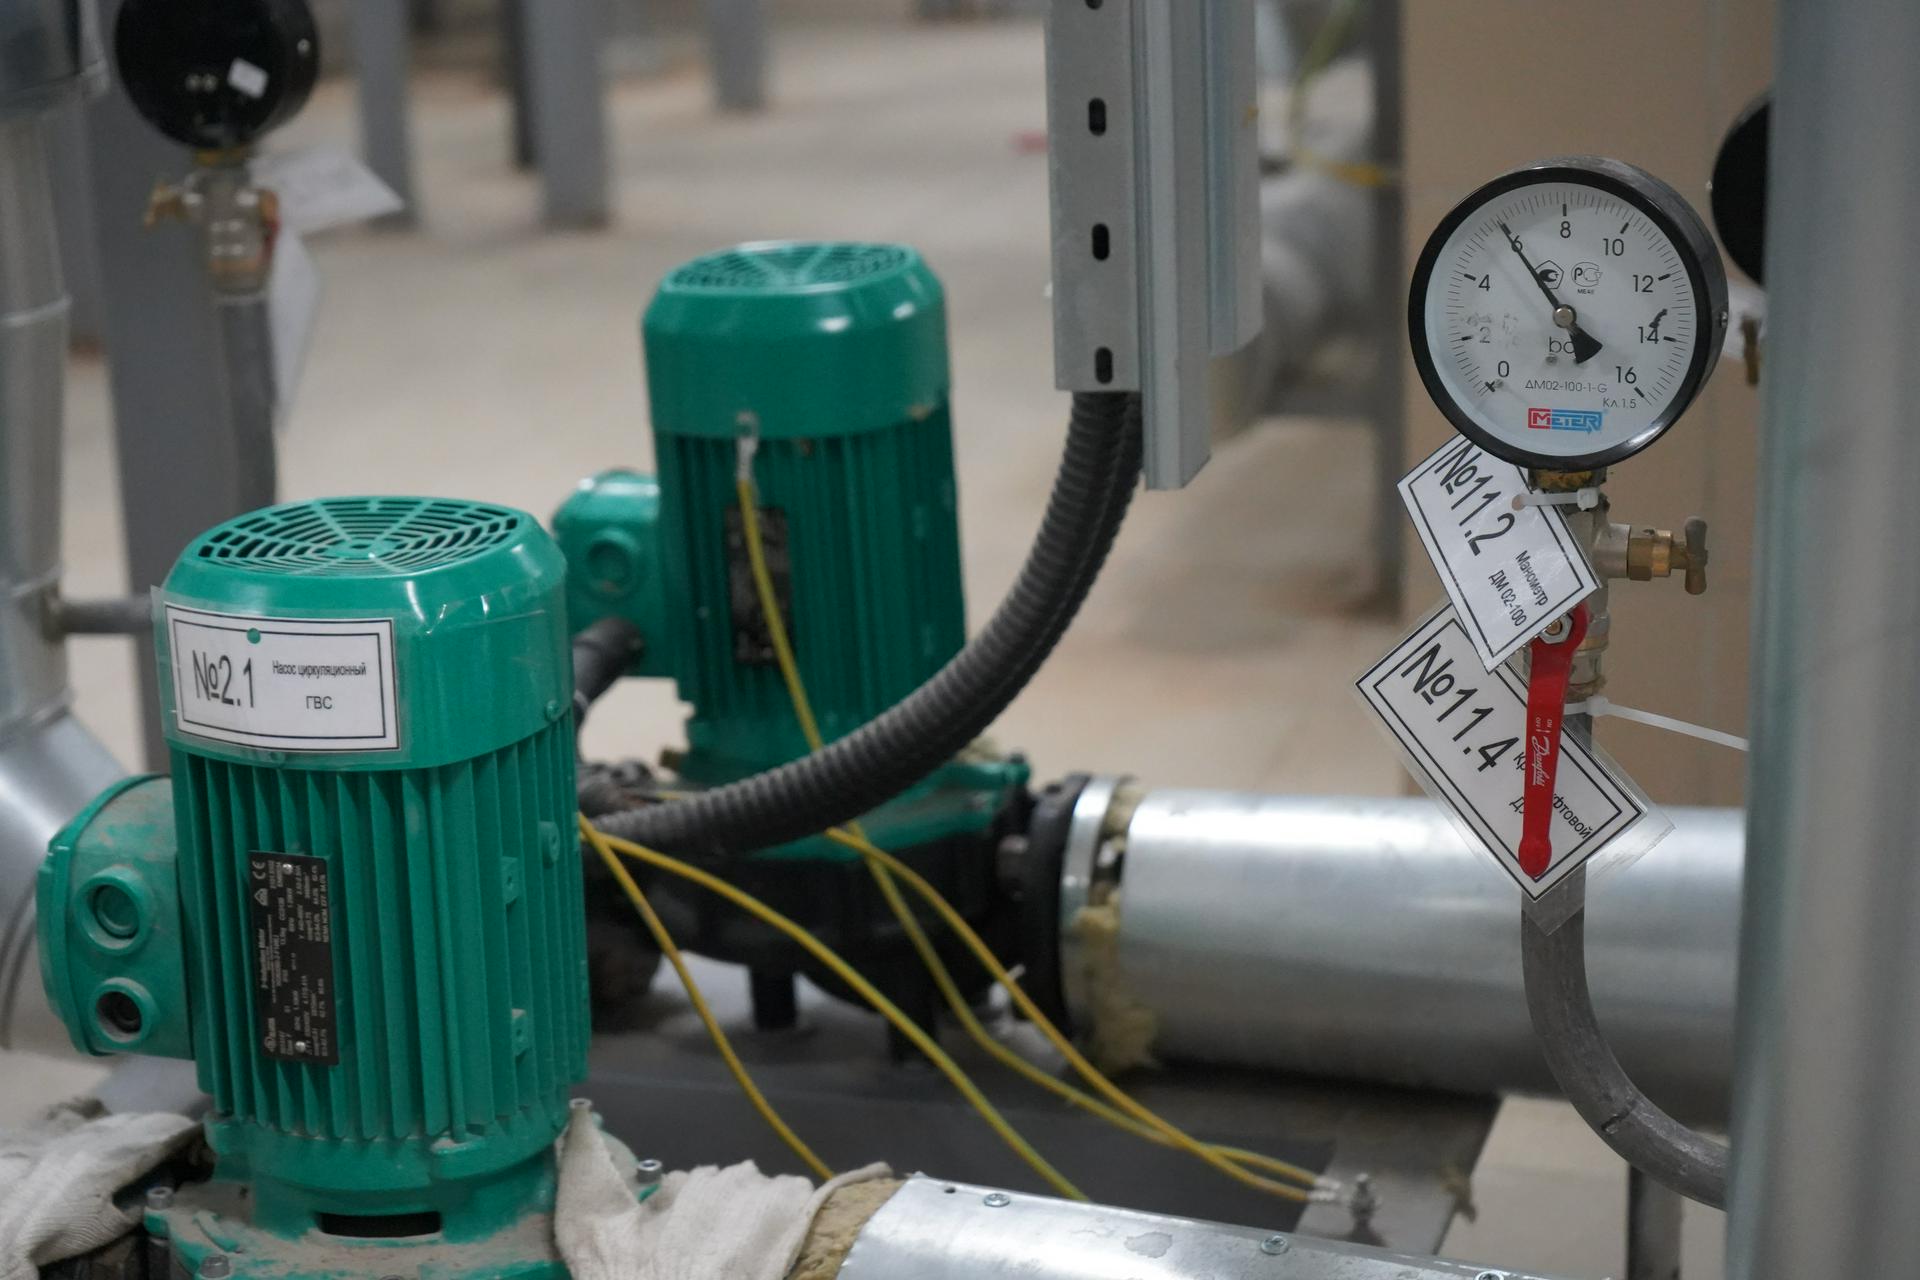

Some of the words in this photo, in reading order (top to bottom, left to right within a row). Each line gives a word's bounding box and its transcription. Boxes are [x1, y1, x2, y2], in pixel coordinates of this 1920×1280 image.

[1560, 220, 1571, 238] 8
[1511, 235, 1523, 252] 6
[1603, 238, 1625, 256] 10
[1478, 274, 1491, 292] 4
[1633, 274, 1654, 293] 12
[1479, 326, 1491, 344] 2
[1638, 326, 1660, 345] 14
[1549, 336, 1577, 354] ba
[1497, 360, 1510, 378] 0
[1615, 366, 1637, 384] 16
[1530, 409, 1602, 431] METER
[1516, 550, 1548, 606] Манометр
[1488, 569, 1510, 592] ДМ
[1501, 588, 1527, 626] 02-100
[192, 650, 255, 708] №2.1
[272, 660, 296, 676] Насос
[298, 662, 367, 679] циркуляционный
[306, 696, 333, 710] ГВС
[1400, 643, 1520, 772] №11.4
[1531, 735, 1550, 787] Danfoss
[1553, 794, 1593, 839] фтовой
